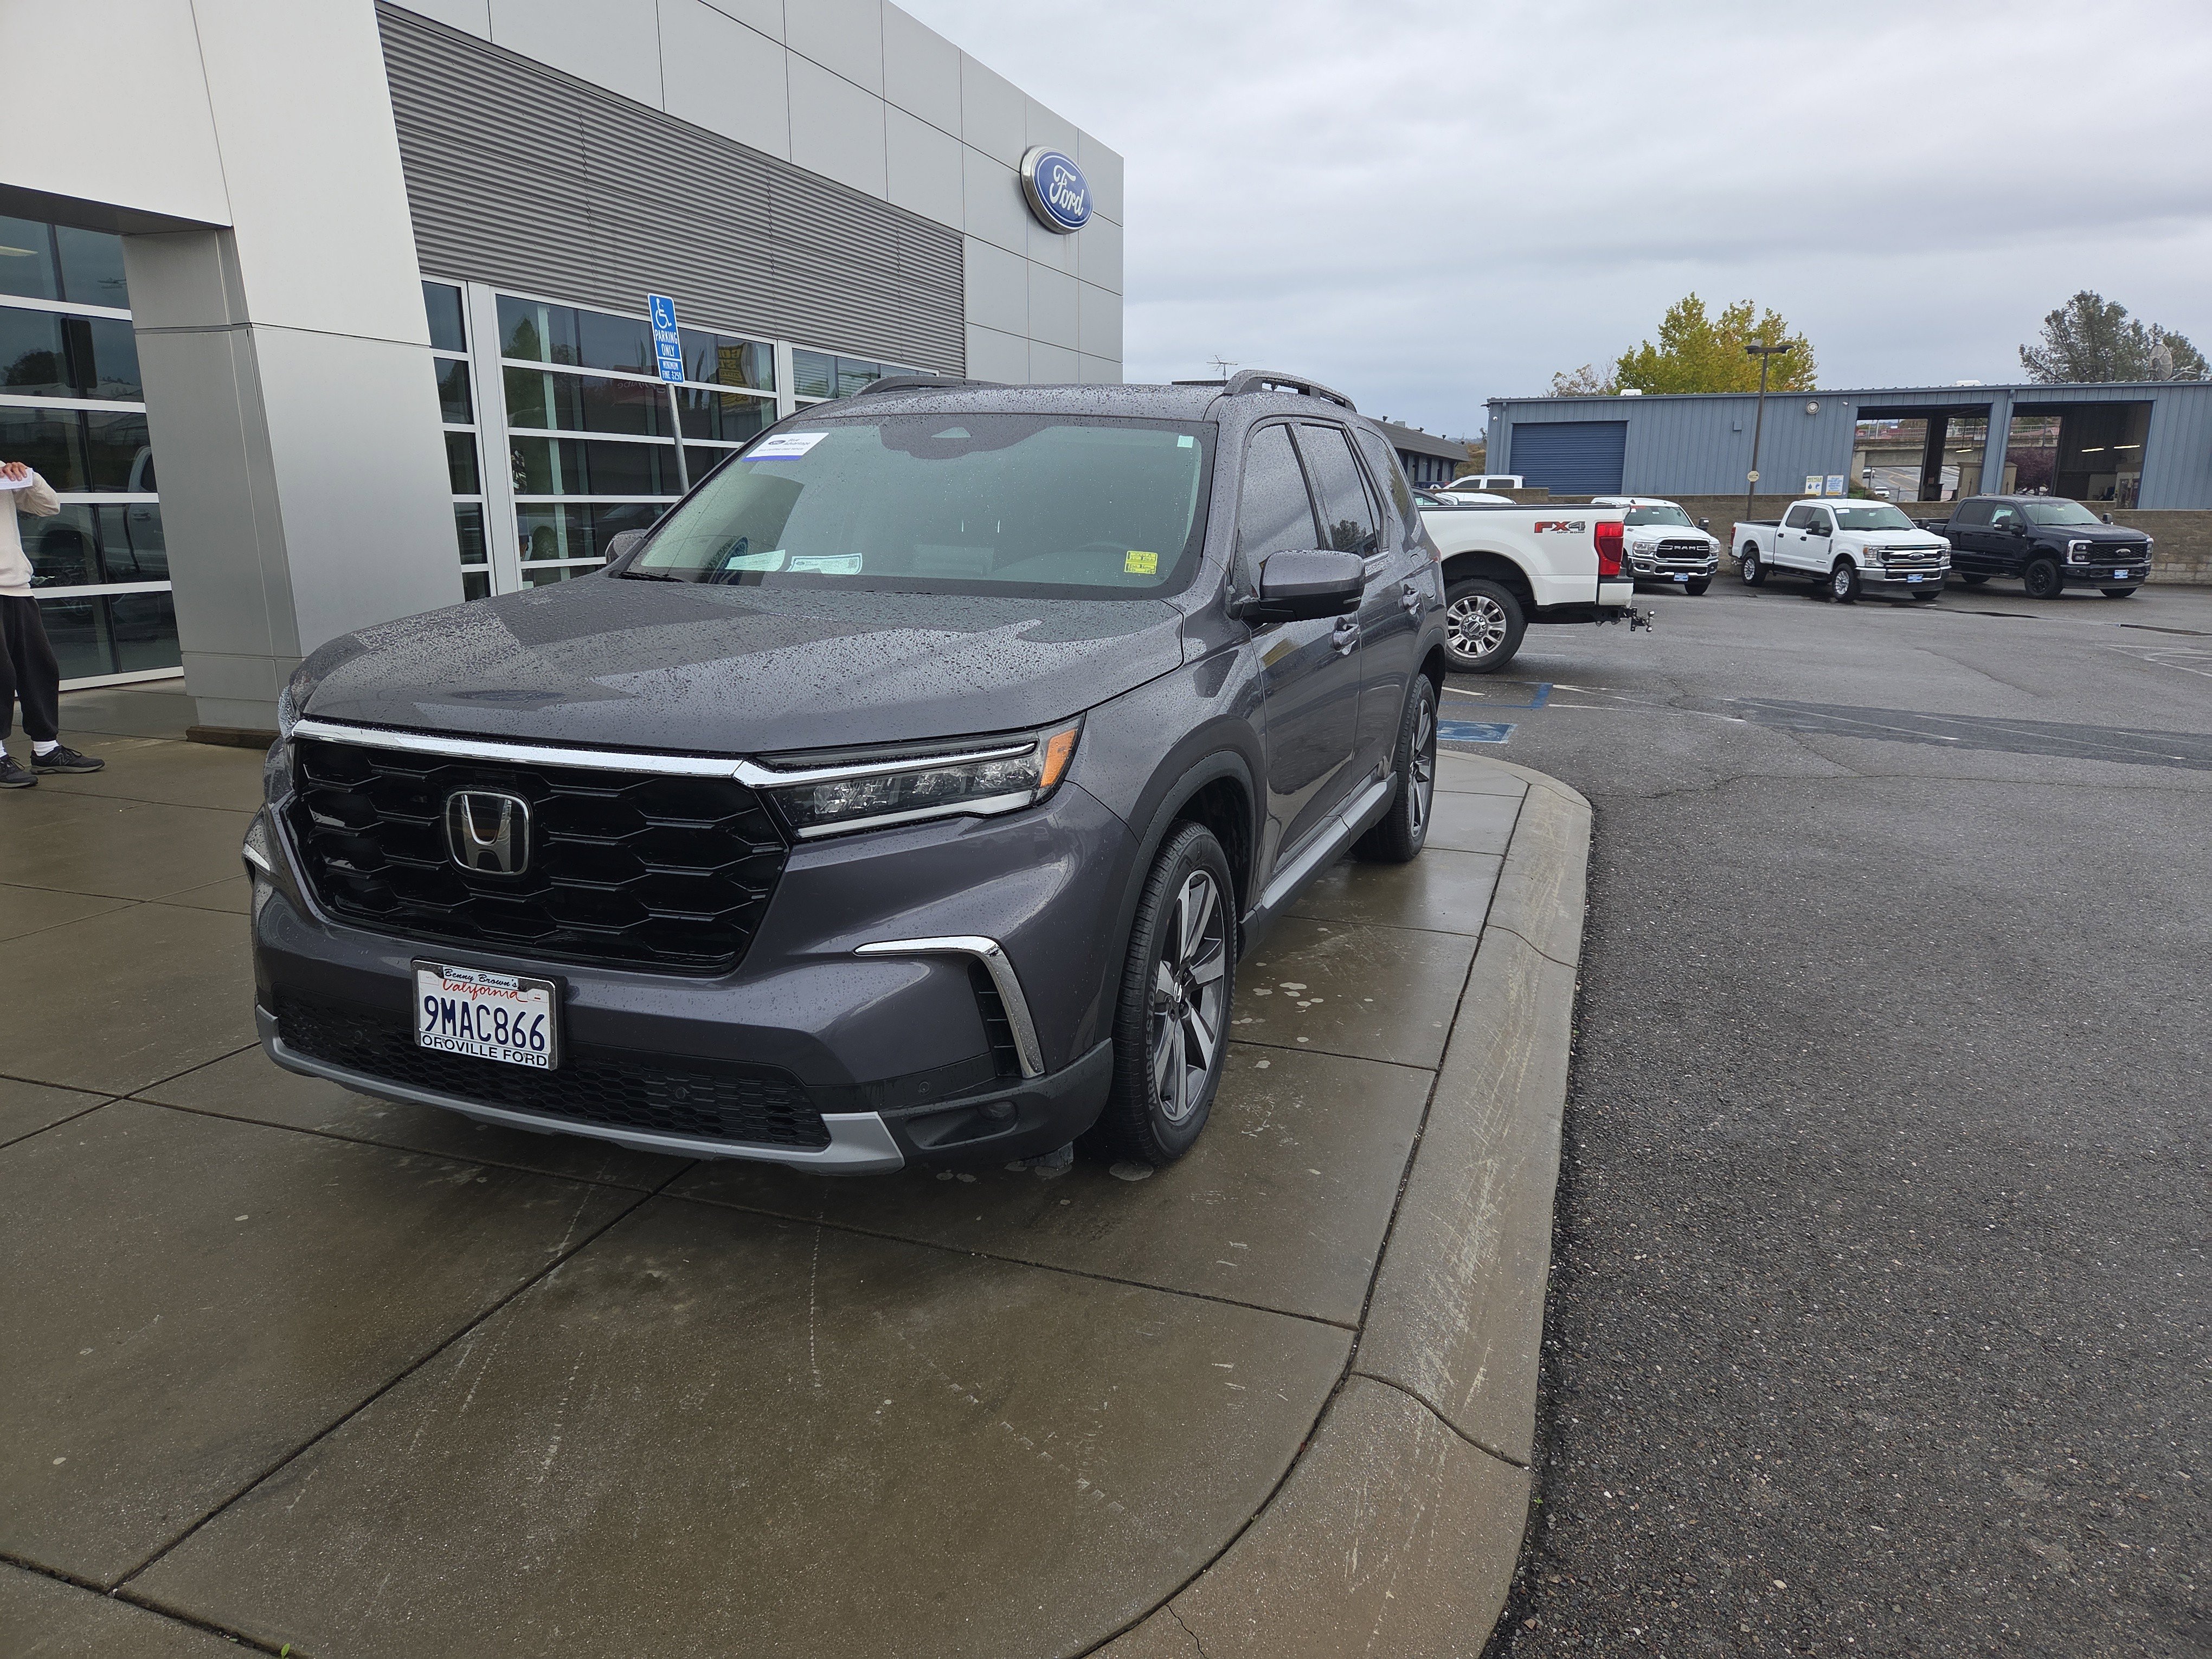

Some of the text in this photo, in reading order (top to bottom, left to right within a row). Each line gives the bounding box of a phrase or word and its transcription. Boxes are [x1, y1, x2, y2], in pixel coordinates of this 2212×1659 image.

[1050, 165, 1084, 216] Ford
[655, 329, 678, 344] PARKING
[661, 343, 674, 357] ONLY
[1534, 521, 1586, 533] FX4
[444, 968, 518, 988] Benny Brown's
[442, 979, 528, 1002] California
[424, 995, 545, 1052] 9MAC866
[422, 1034, 548, 1066] OROVILLE FORD
